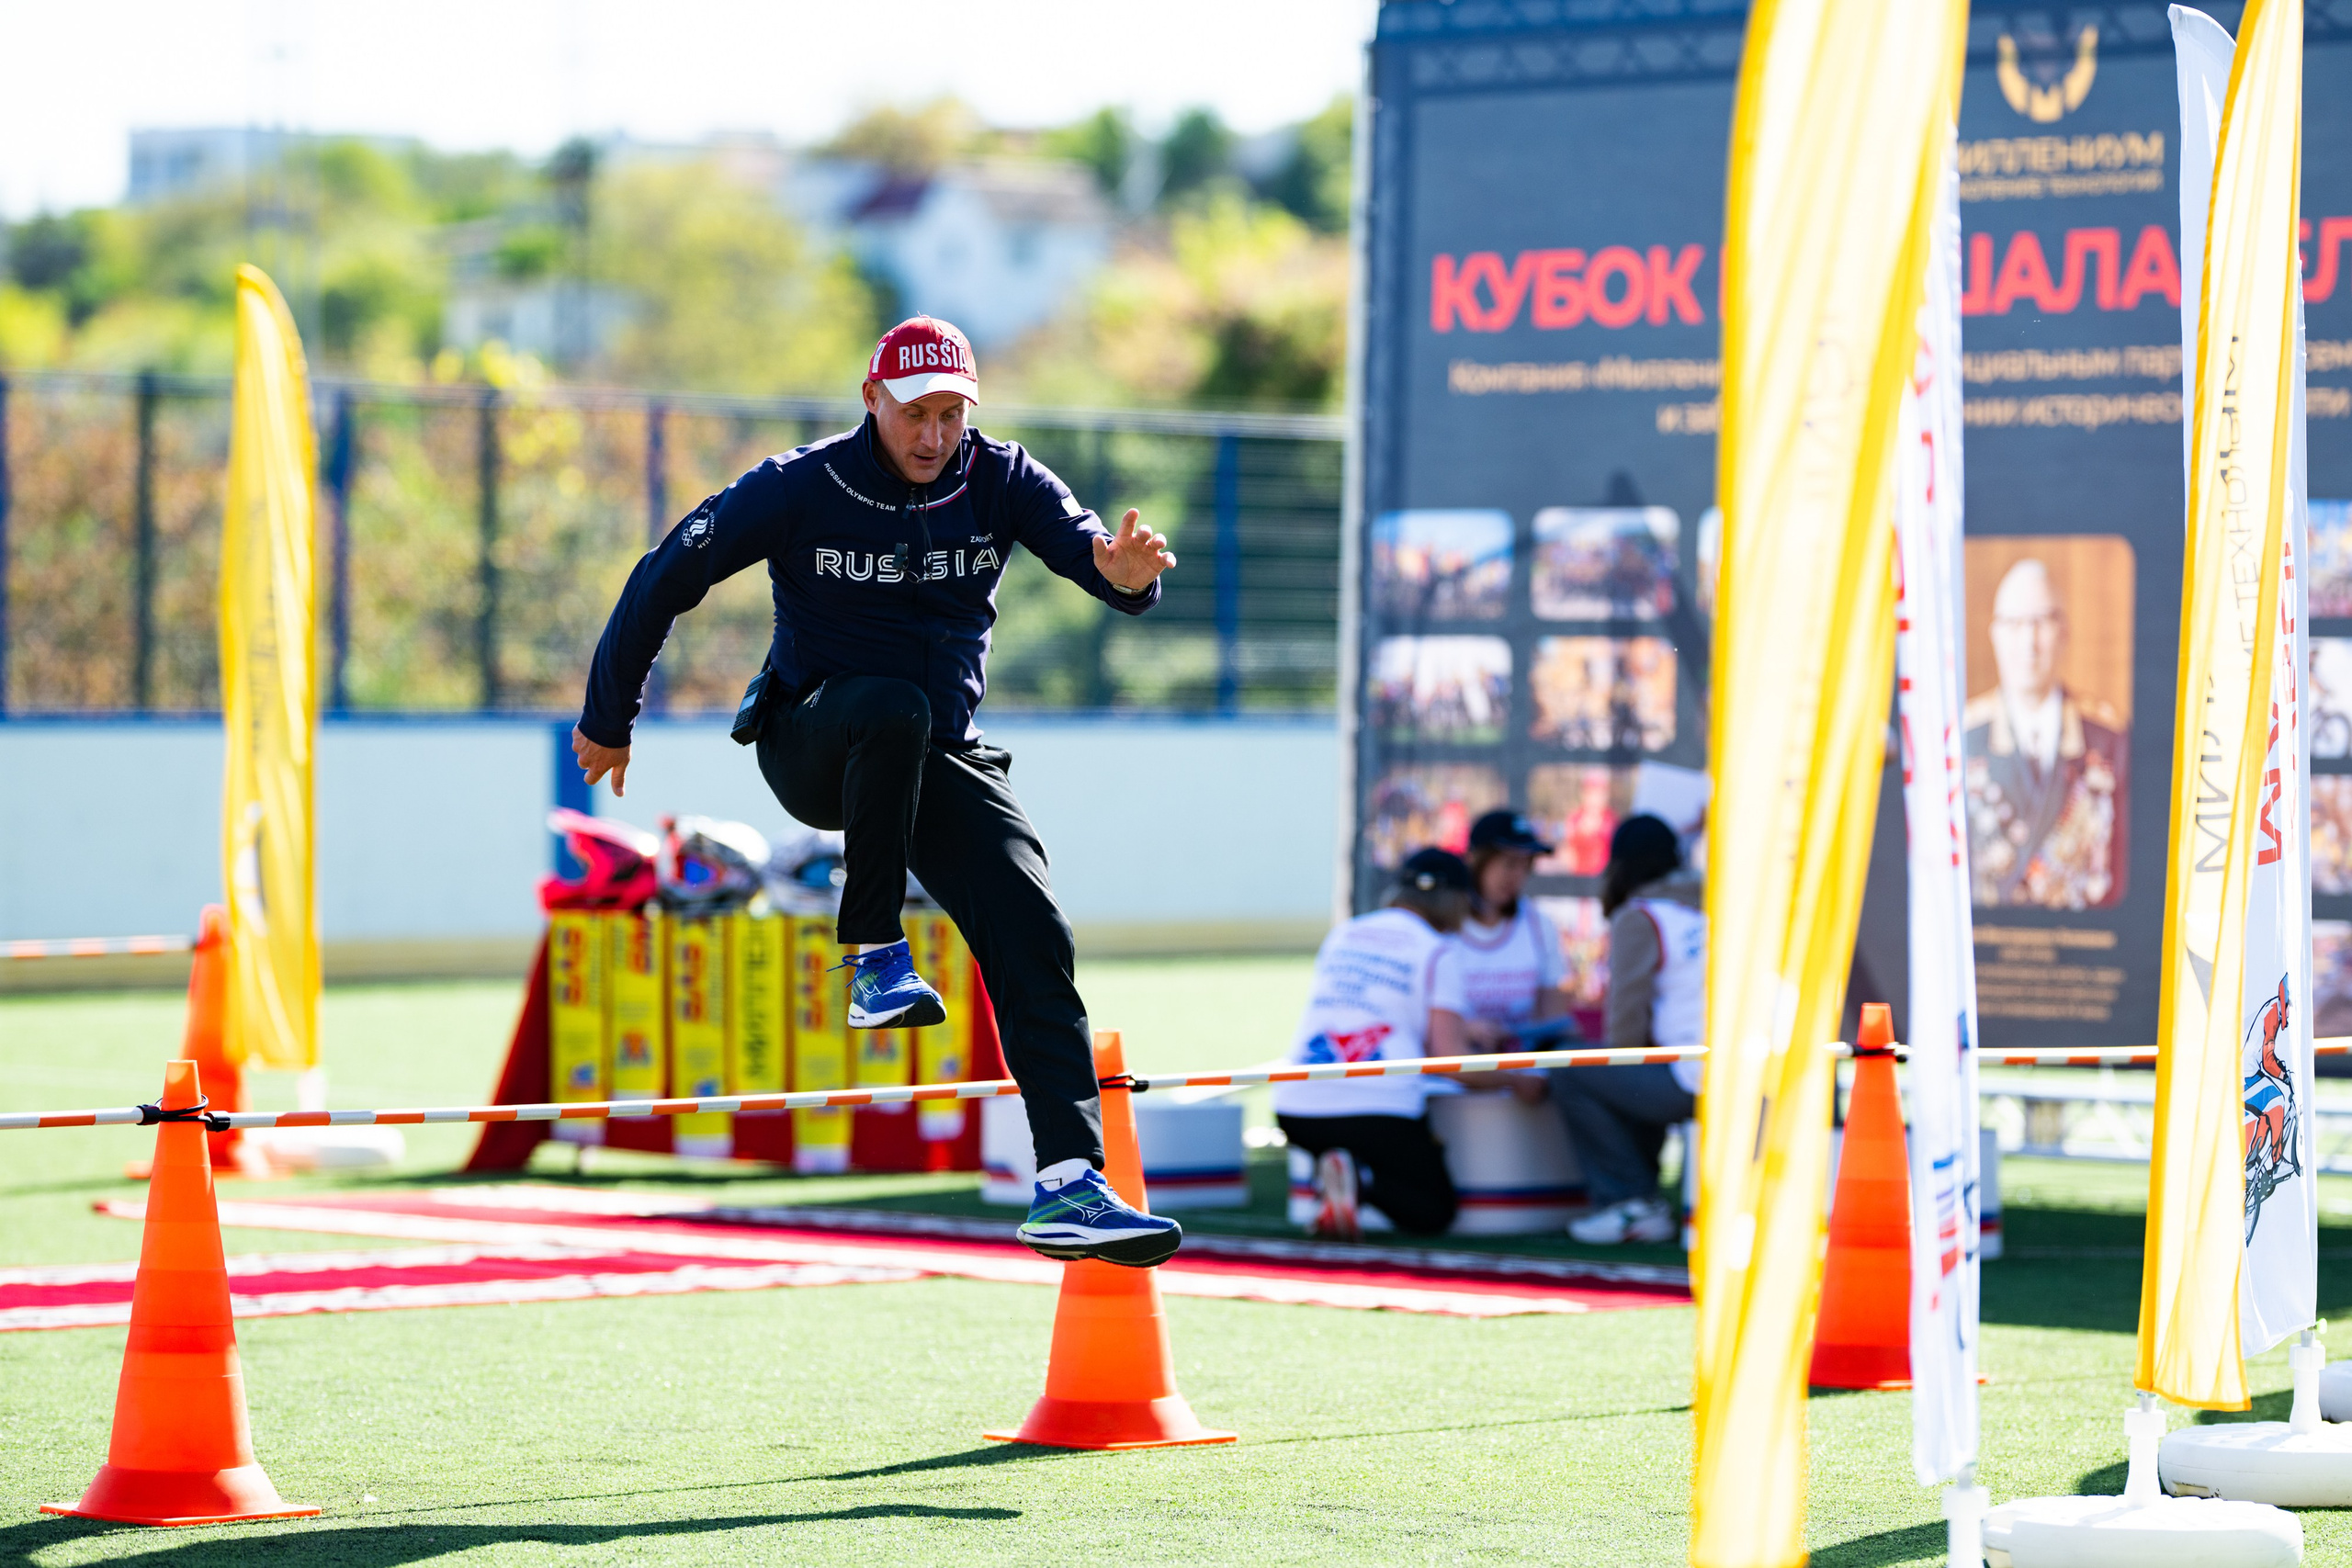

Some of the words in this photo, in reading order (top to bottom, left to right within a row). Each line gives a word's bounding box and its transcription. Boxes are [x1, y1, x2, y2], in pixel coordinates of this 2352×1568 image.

[1958, 131, 2165, 175] ИЛЛЕНИУМ
[1430, 243, 1706, 333] КУБОК
[899, 343, 967, 372] RUSSIA
[823, 462, 847, 489] RUSSIAN
[845, 487, 875, 506] OLYMPIC
[876, 502, 897, 512] TEAM
[816, 547, 1000, 583] RUSSIA
